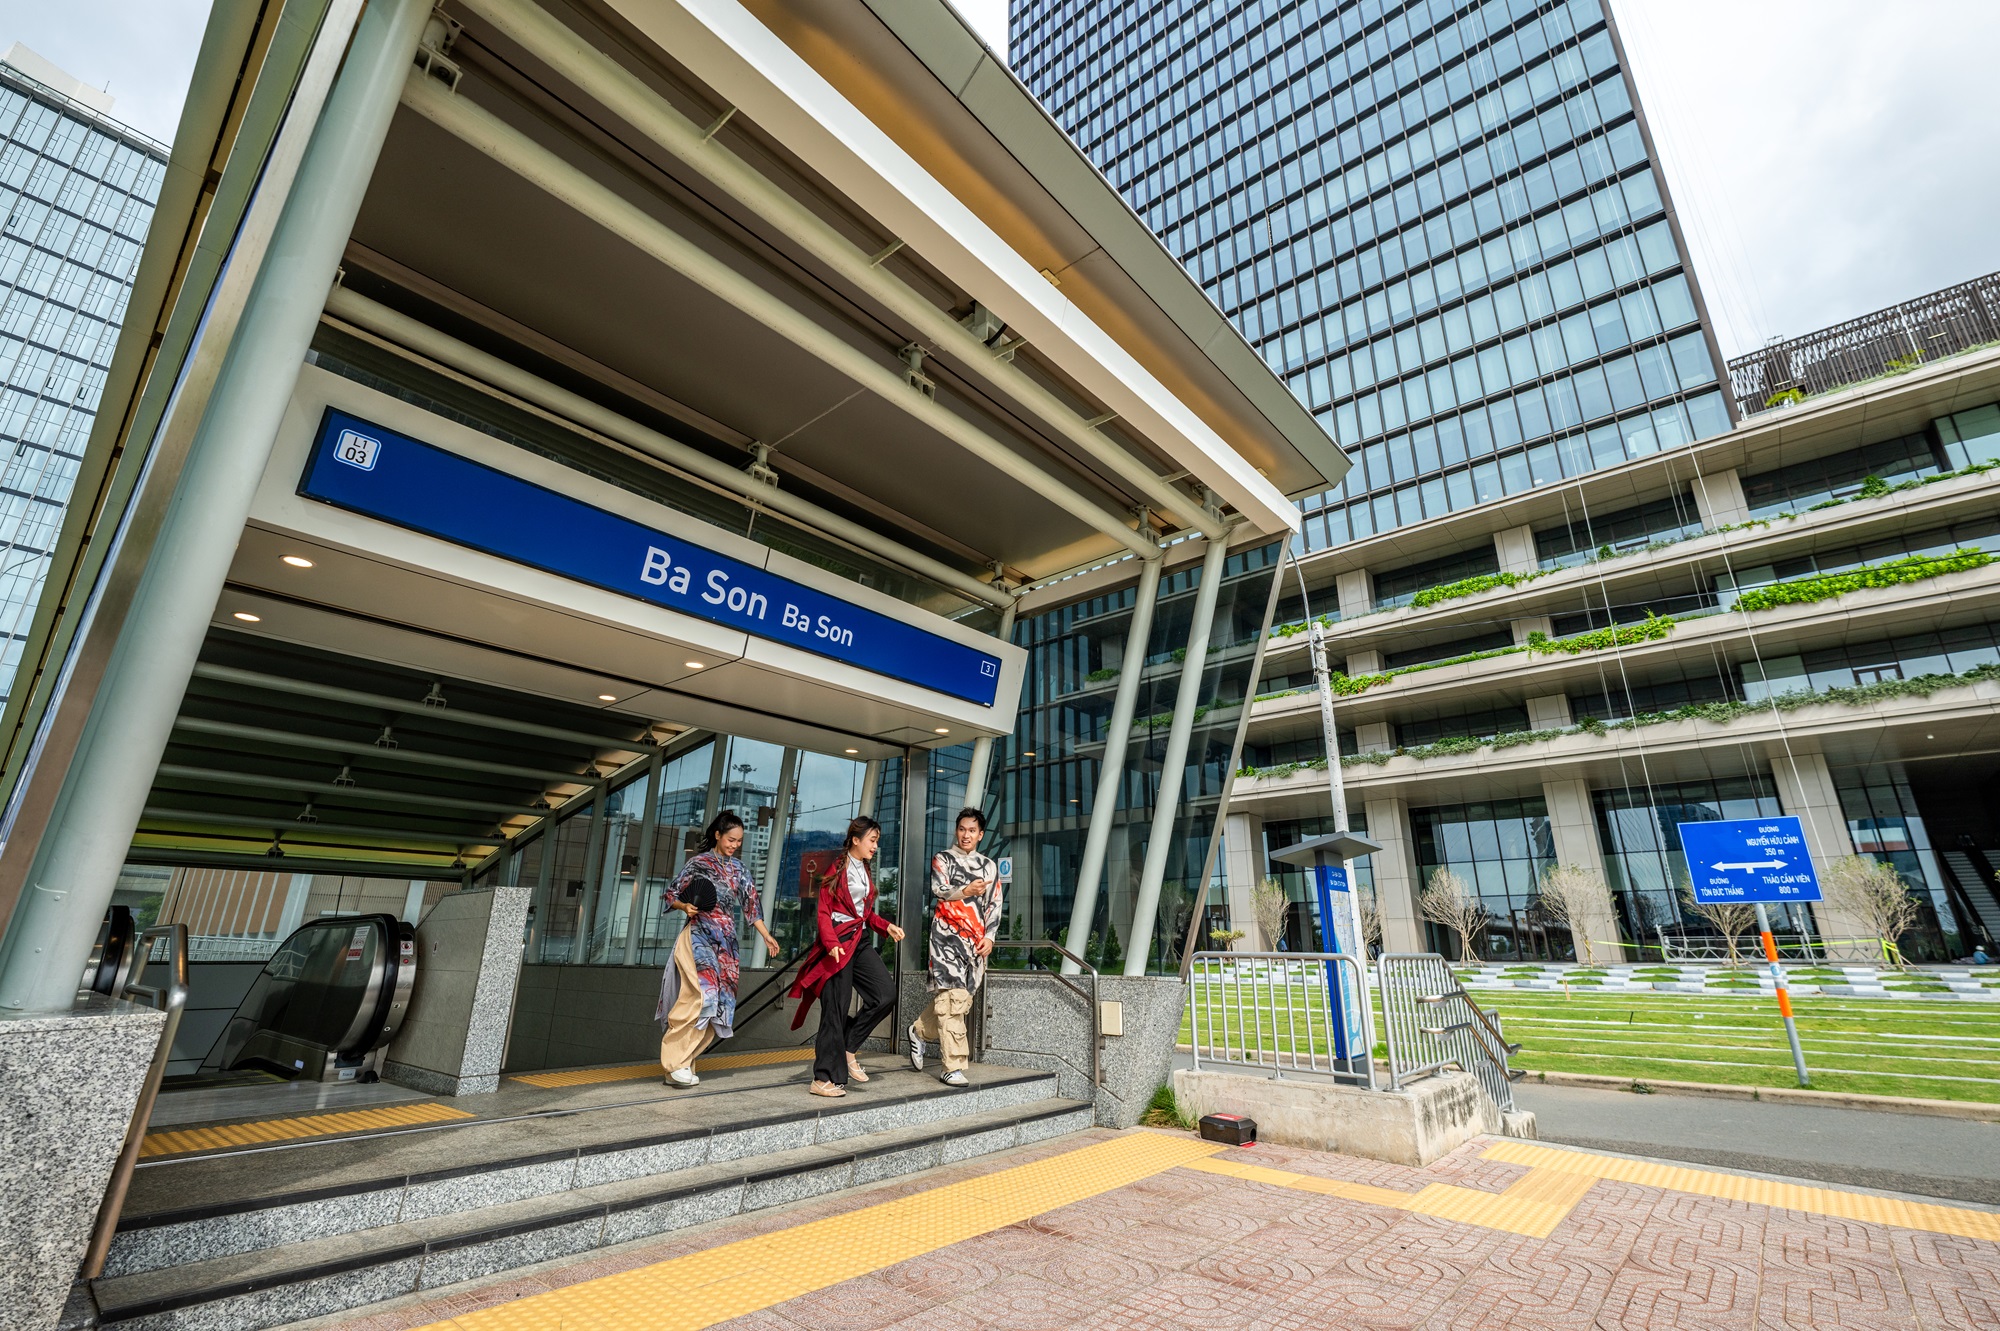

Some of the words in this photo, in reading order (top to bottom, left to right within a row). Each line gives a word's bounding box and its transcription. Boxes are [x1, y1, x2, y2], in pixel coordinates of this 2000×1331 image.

[353, 437, 367, 449] L1
[346, 447, 366, 463] 03
[641, 546, 691, 594] Ba
[702, 570, 767, 619] Son
[782, 603, 810, 632] Ba
[815, 616, 853, 646] Son
[1764, 848, 1776, 856] 350
[1778, 886, 1791, 894] 800
